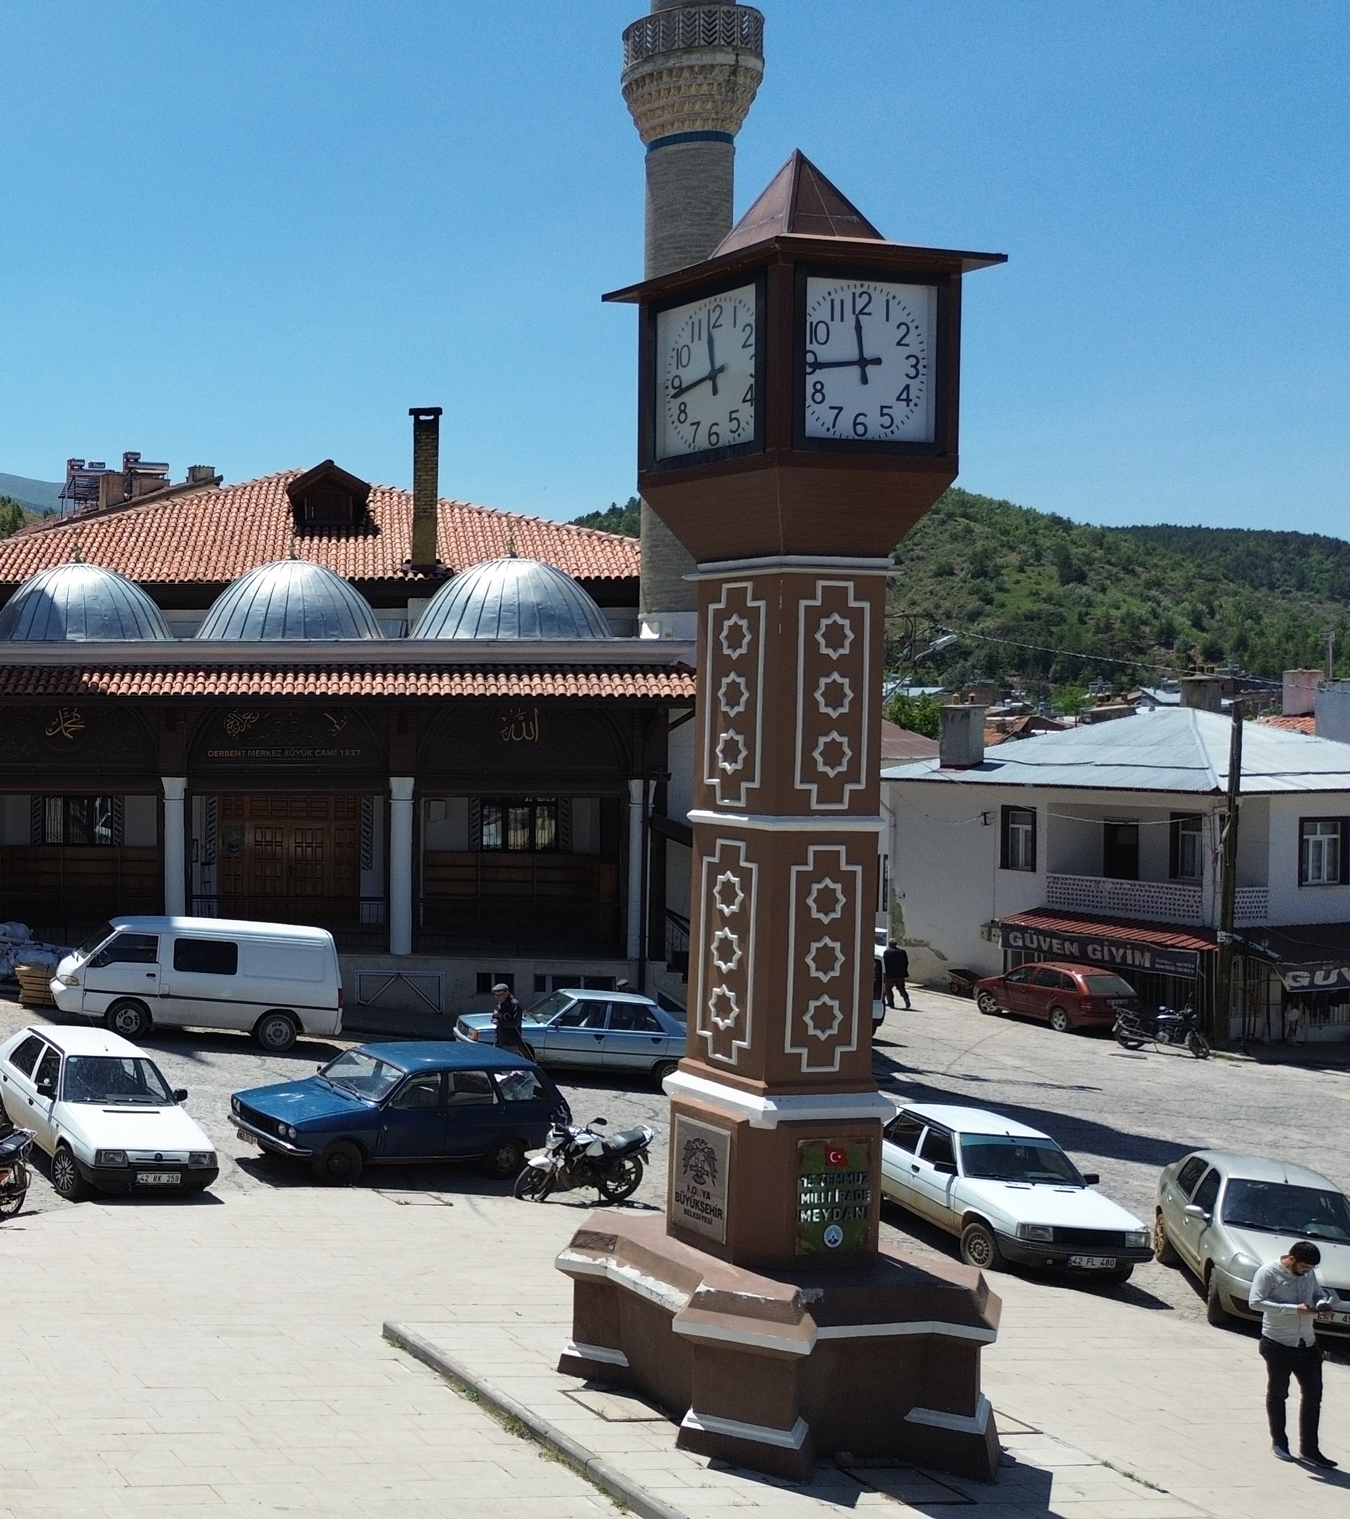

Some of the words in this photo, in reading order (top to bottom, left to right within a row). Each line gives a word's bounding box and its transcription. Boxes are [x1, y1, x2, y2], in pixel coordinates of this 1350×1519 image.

[830, 298, 844, 322] 11
[852, 291, 872, 316] 12
[885, 299, 890, 322] 1
[733, 305, 737, 328] 1
[691, 319, 702, 343] 11
[741, 323, 754, 349] 2
[809, 320, 830, 345] 10
[896, 322, 910, 347] 2
[676, 344, 691, 370] 10
[805, 349, 818, 375] 9
[904, 354, 920, 379] 3
[742, 383, 755, 407] 4
[811, 380, 826, 404] 8
[896, 384, 912, 407] 4
[677, 402, 688, 424] 8
[729, 409, 741, 433] 5
[829, 406, 844, 429] 7
[853, 412, 868, 437] 6
[880, 405, 894, 429] 5
[690, 421, 701, 444] 7
[708, 423, 720, 447] 6
[247, 749, 282, 757] MERKEZ
[284, 748, 313, 757] BÜYÜK
[1008, 930, 1080, 957] GÜVEN
[1087, 941, 1151, 968] GİYİM
[687, 1184, 712, 1201] KOYA
[675, 1191, 723, 1220] BÜYÜKŞEHİR
[1072, 1257, 1083, 1265] 42
[1086, 1257, 1096, 1266] FL
[1100, 1258, 1115, 1266] 480
